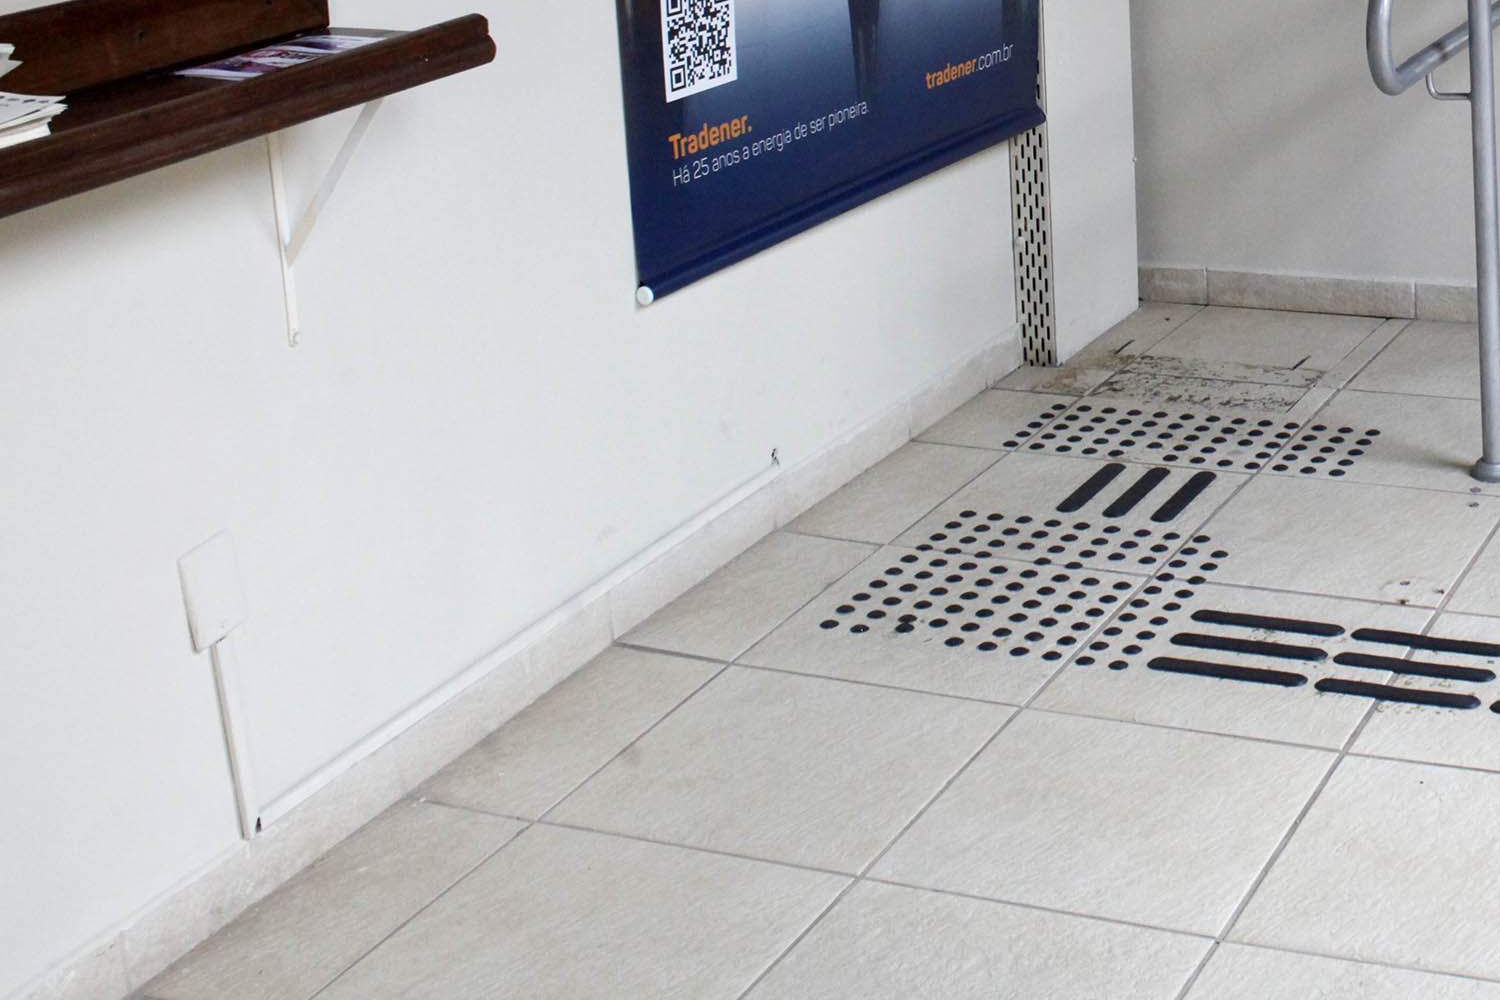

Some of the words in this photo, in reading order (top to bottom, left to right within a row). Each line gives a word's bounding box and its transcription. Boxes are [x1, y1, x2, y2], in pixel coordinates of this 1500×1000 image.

[925, 43, 1014, 90] tradener.com.br
[669, 114, 753, 160] Tradener.
[673, 164, 690, 187] Há
[693, 159, 710, 180] 25
[711, 151, 741, 174] anos
[742, 147, 750, 160] a
[752, 130, 792, 155] energia
[794, 124, 808, 139] de
[810, 117, 826, 134] ser
[828, 100, 870, 131] pioneira.
